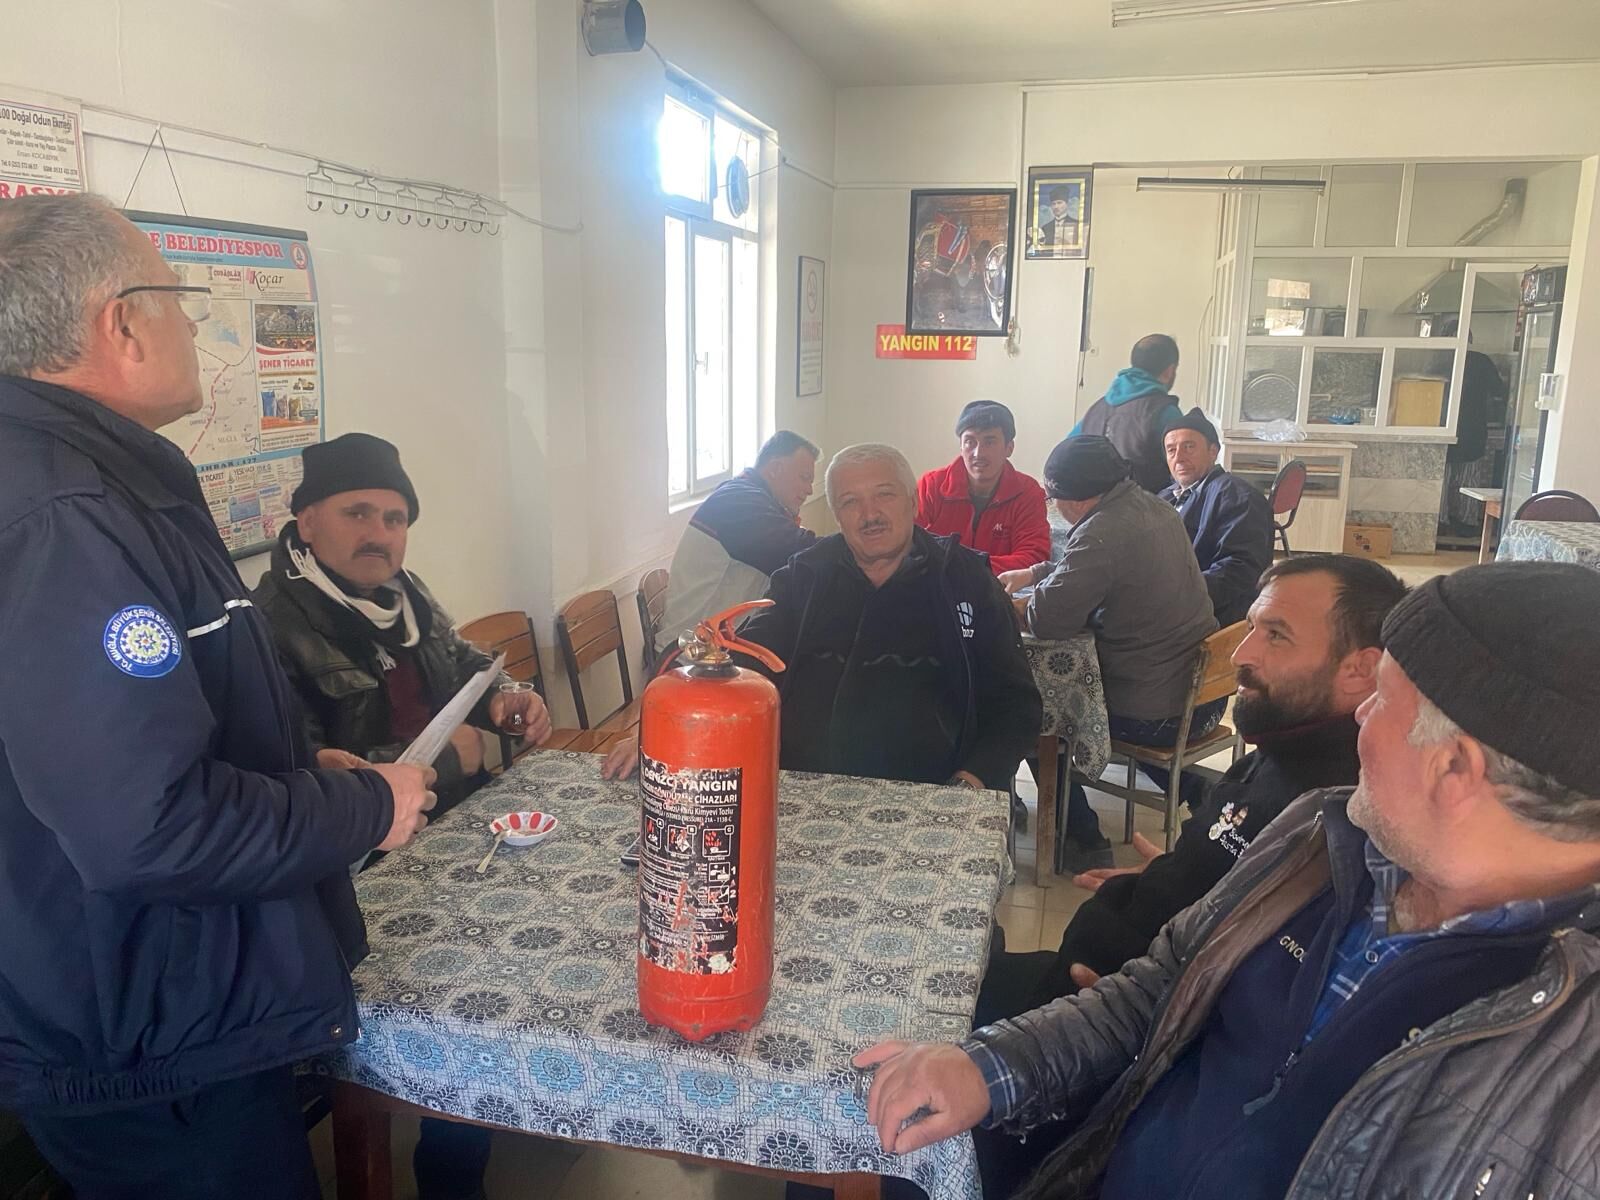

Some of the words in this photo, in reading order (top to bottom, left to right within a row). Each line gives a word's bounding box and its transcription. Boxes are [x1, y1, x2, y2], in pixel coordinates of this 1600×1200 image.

[12, 109, 31, 126] Doğal
[33, 113, 51, 127] Odun
[165, 233, 283, 258] BELEDİYESPOR
[251, 270, 283, 291] Koçar
[880, 335, 939, 351] YANGIN
[945, 336, 972, 351] 112
[259, 359, 281, 370] ŞENER
[283, 356, 315, 368] TİCARET
[680, 777, 738, 792] YANGIN
[694, 793, 738, 804] CİHAZLARI
[694, 807, 718, 817] Kimyevi
[719, 807, 734, 815] Tozlu
[731, 866, 737, 875] 1
[730, 889, 737, 899] 2
